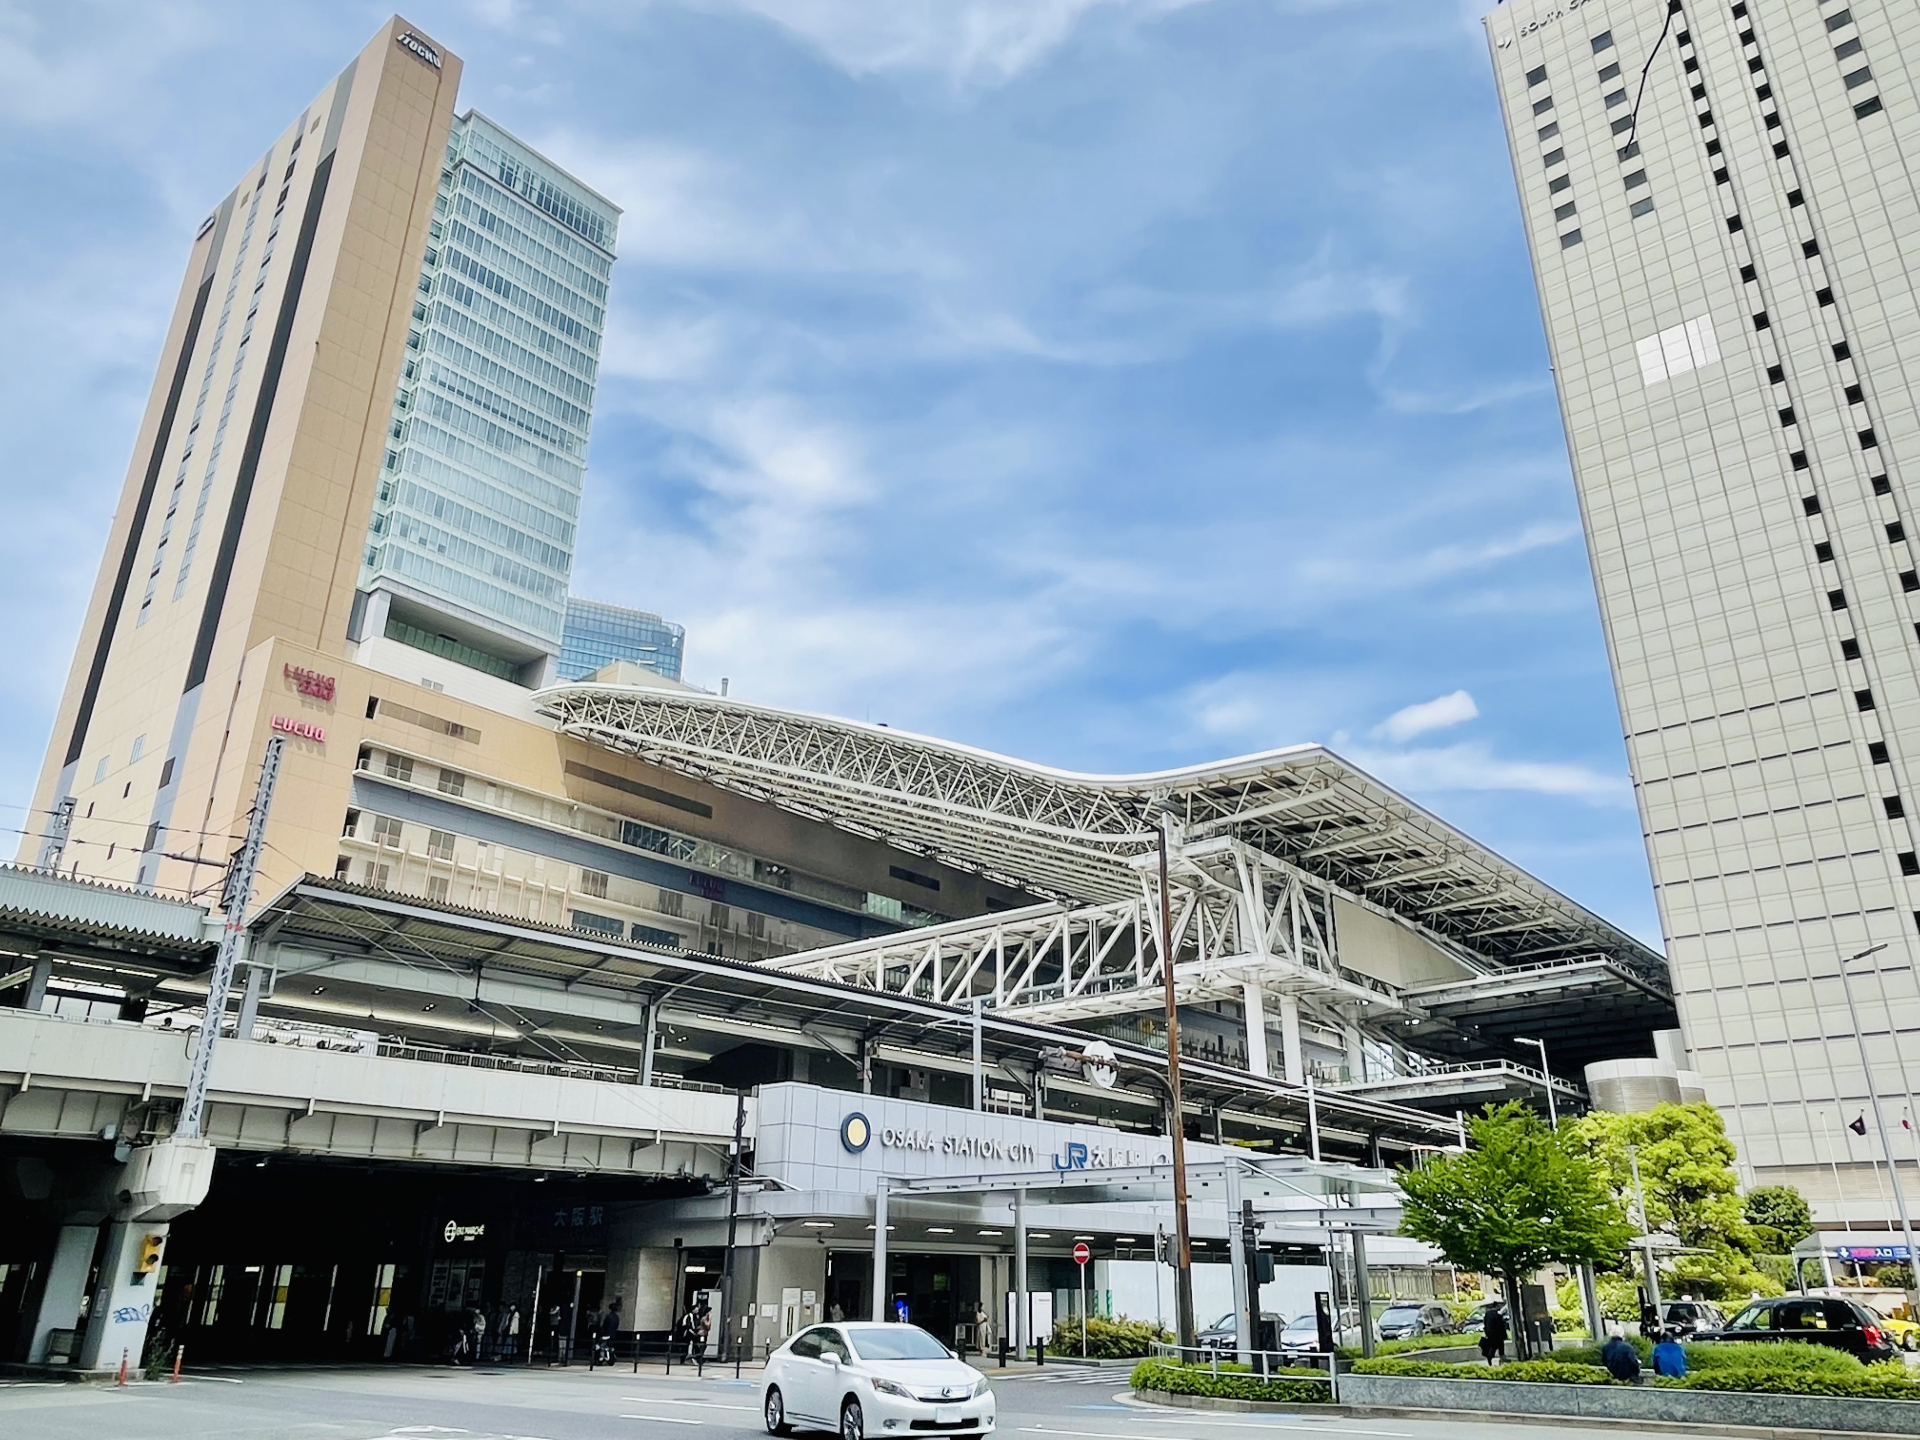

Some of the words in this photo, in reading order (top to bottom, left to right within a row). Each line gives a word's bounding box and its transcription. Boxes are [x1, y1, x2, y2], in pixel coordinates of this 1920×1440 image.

[396, 31, 442, 69] ITOCHU
[271, 714, 325, 742] LUCUA
[881, 1127, 935, 1153] OSAKA
[943, 1134, 1003, 1160] STATION
[1008, 1143, 1037, 1164] CITY
[1053, 1142, 1088, 1170] JR
[554, 1206, 603, 1226] 大阪駅
